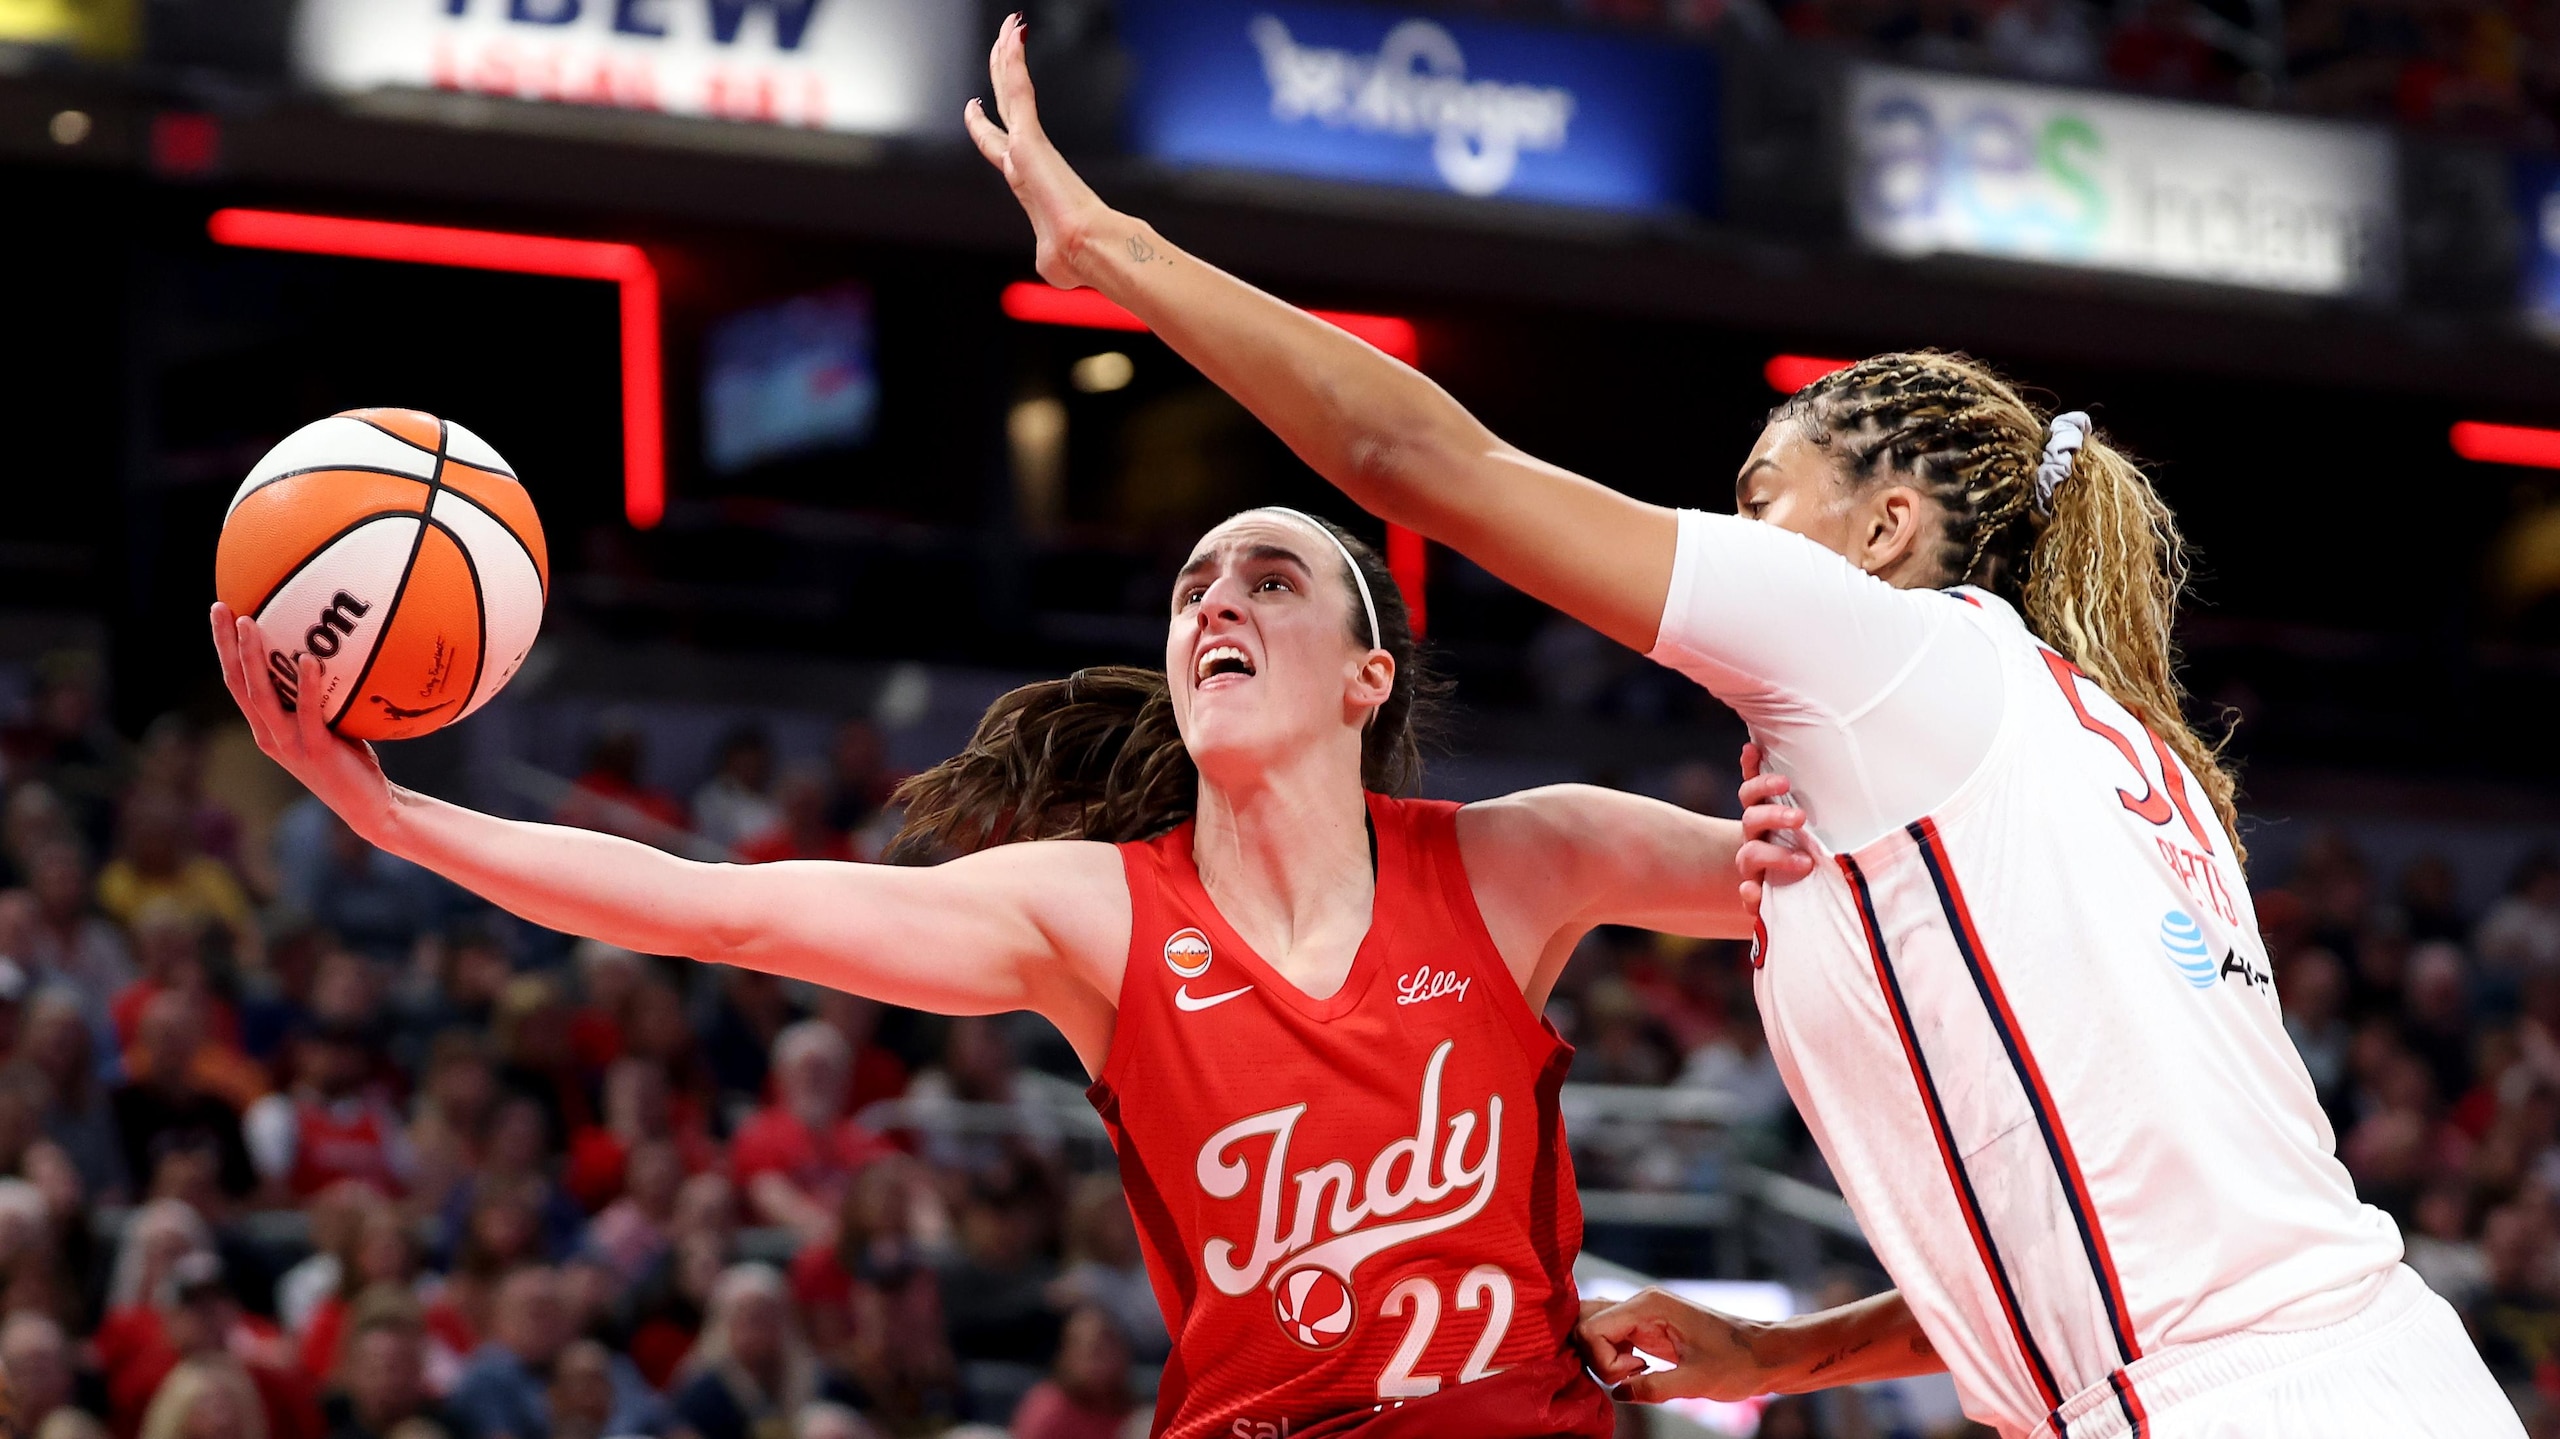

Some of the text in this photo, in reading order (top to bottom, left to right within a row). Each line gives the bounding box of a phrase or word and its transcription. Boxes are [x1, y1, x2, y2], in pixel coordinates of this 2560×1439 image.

[1396, 964, 1472, 1006] Lilly
[1196, 1039, 1504, 1296] Indy
[1375, 1264, 1517, 1401] 22
